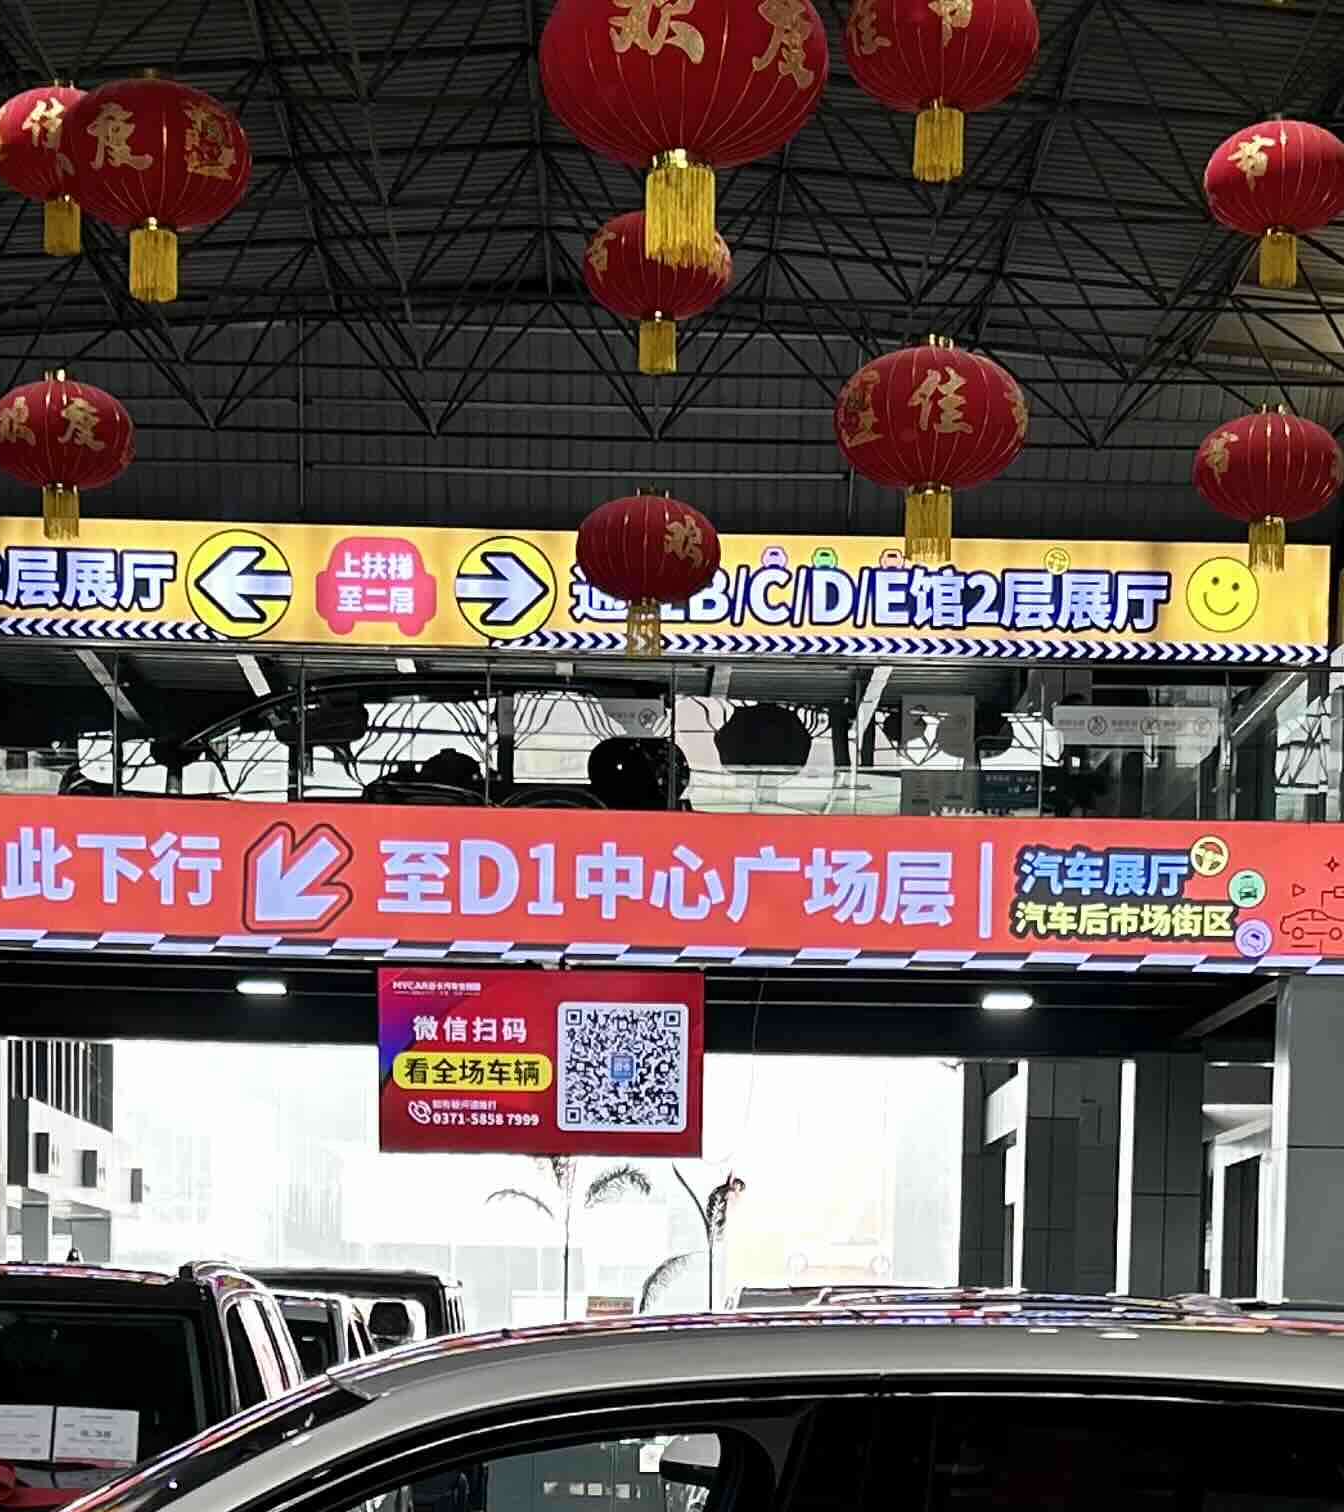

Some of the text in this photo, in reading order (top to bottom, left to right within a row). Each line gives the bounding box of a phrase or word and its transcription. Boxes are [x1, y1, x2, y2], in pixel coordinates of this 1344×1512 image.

[334, 551, 414, 581] 上扶梯
[334, 586, 414, 616] 至二层
[377, 839, 955, 927] 至D1中心广场层
[1020, 851, 1189, 897] 汽车展厅
[1014, 901, 1234, 939] 汽车后市场街区
[413, 1014, 527, 1043] 微信扫码
[404, 1057, 541, 1087] 看全场车辆
[432, 1112, 540, 1126] 0371-5858 7999
